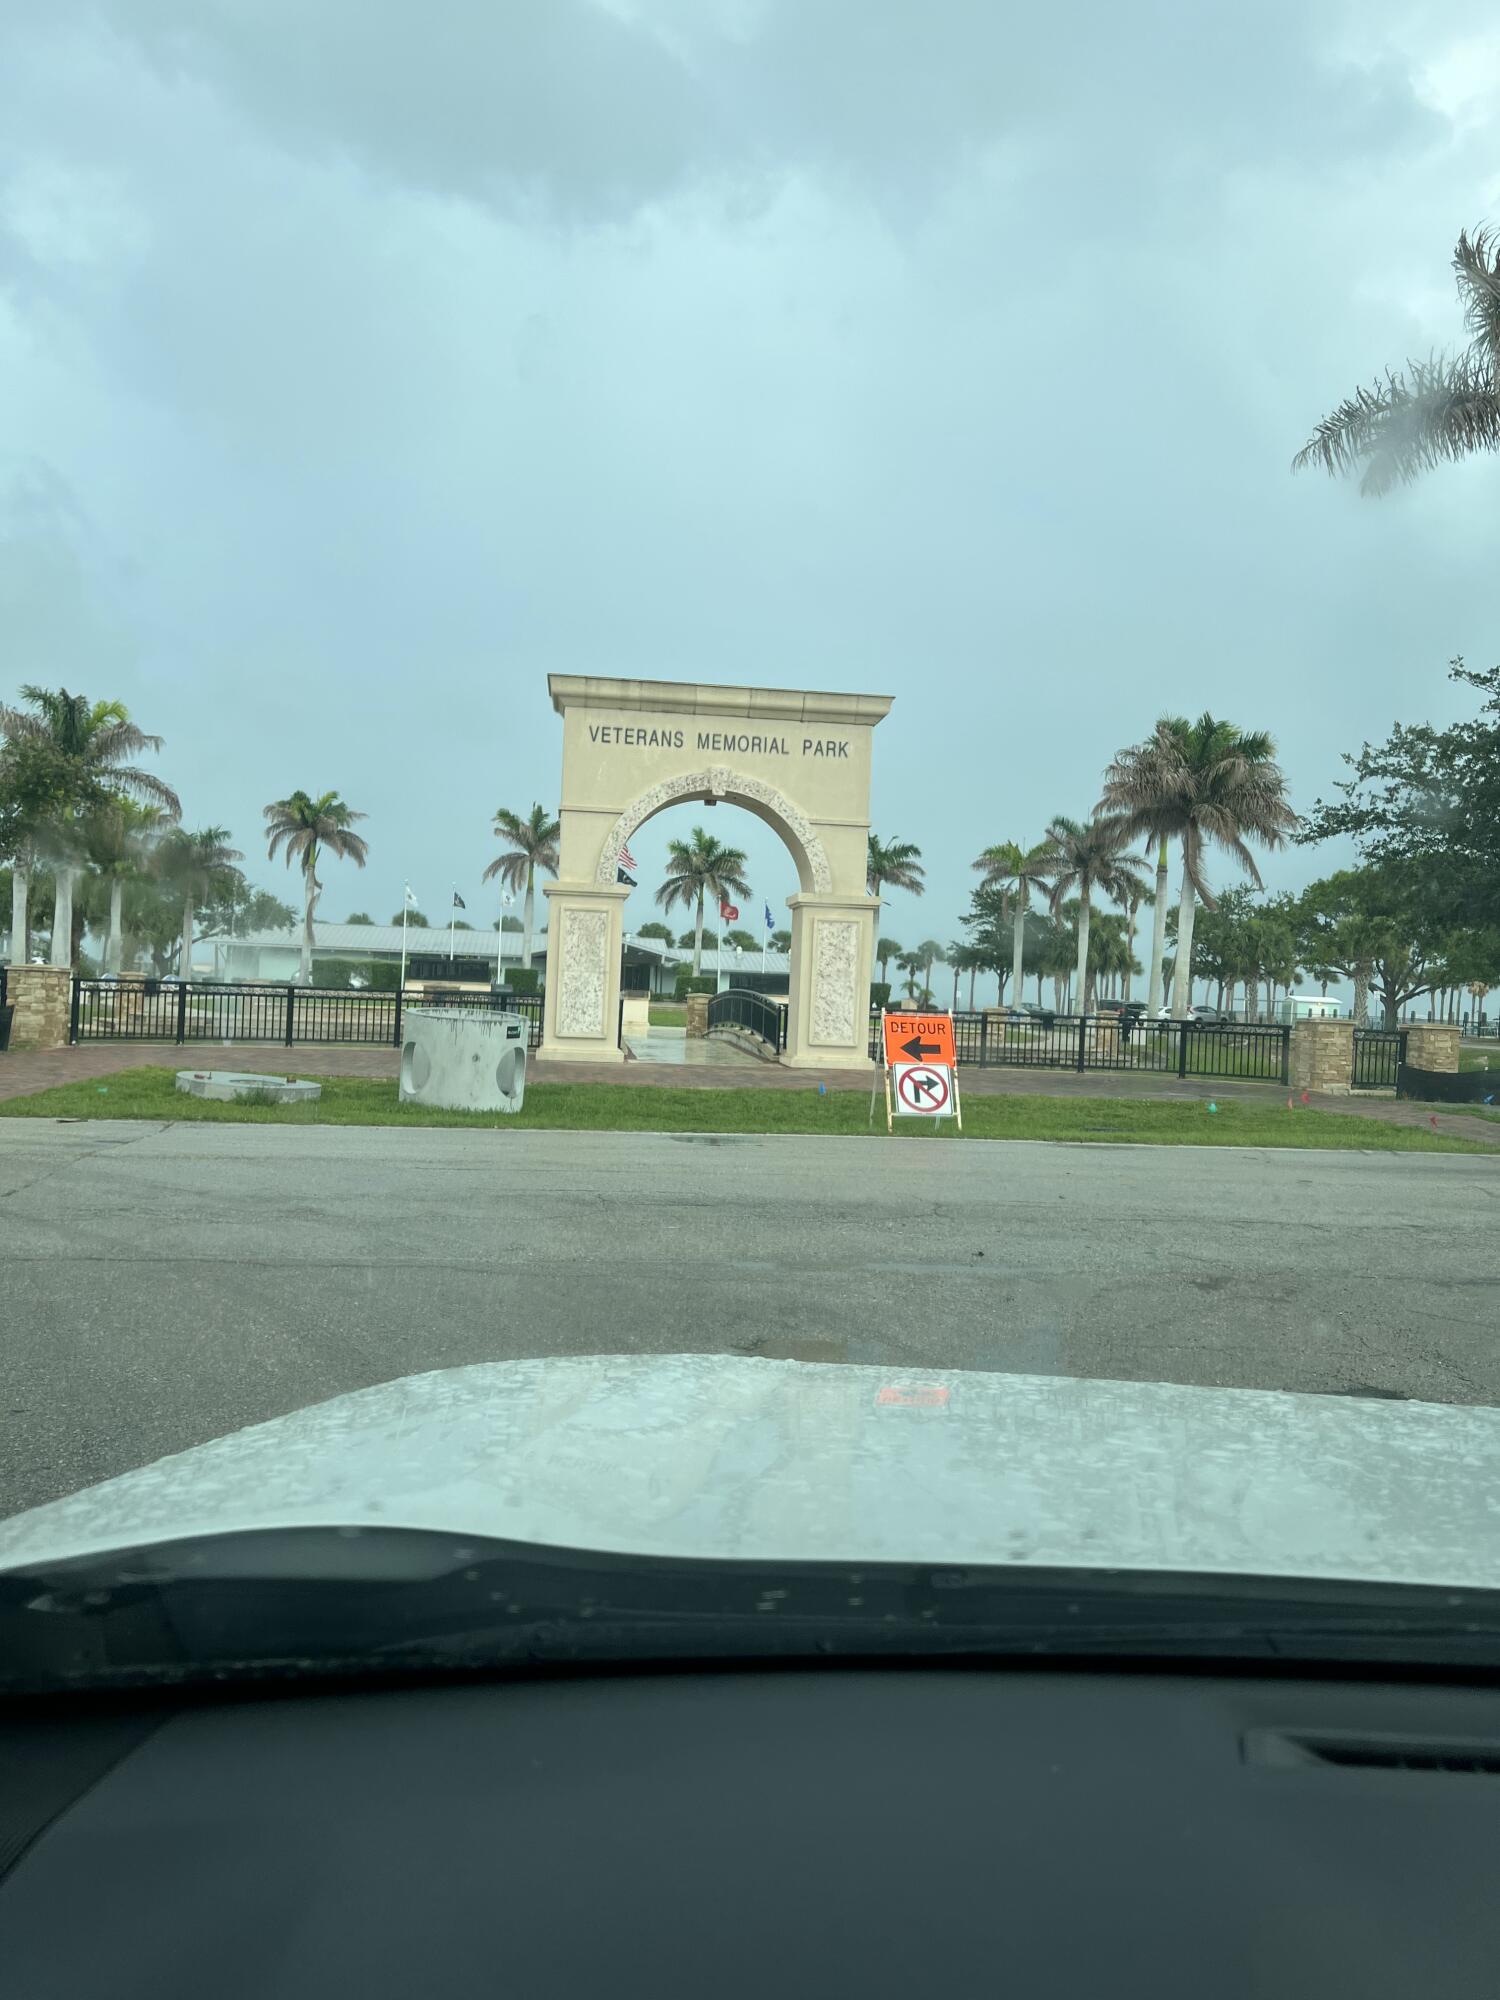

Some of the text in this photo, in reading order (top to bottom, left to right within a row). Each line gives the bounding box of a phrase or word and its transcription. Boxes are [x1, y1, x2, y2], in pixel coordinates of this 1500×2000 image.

[589, 726, 849, 758] VETERANS MEMORIAL PARK
[890, 1021, 946, 1035] DETOUR
